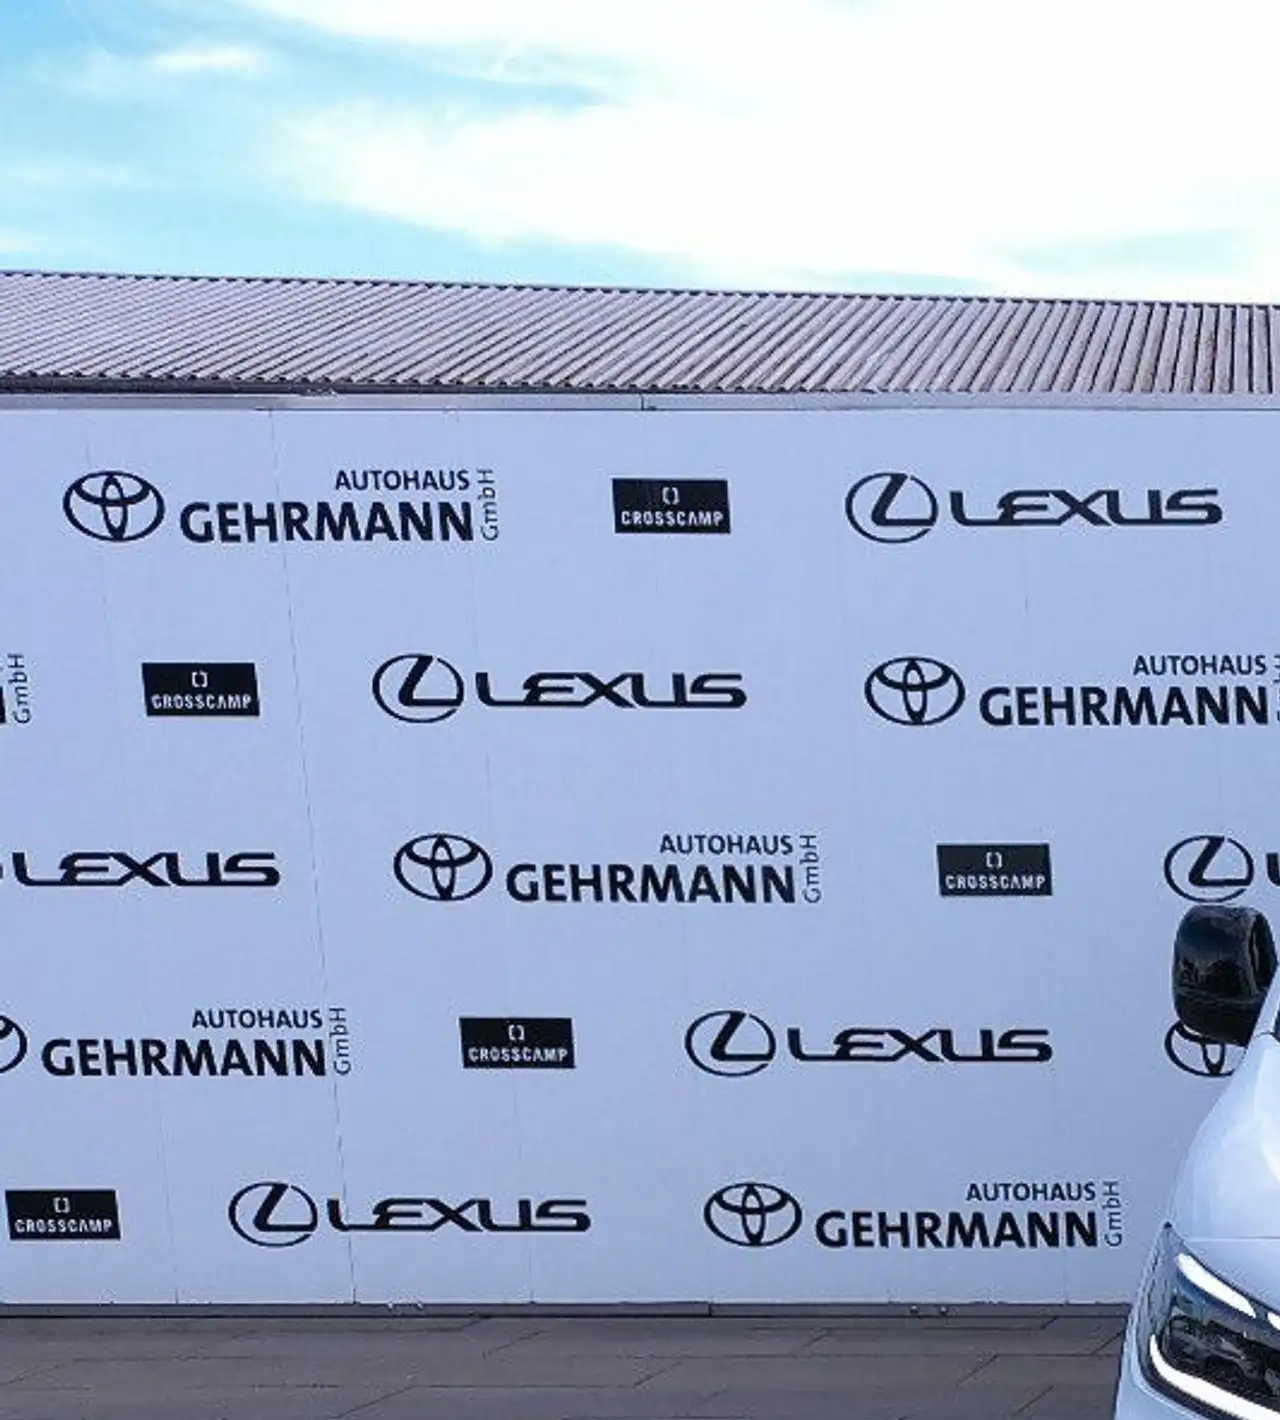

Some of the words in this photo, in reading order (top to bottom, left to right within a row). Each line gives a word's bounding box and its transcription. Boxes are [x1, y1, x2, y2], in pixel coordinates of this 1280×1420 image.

[334, 470, 470, 491] AUTOHAUS
[180, 501, 474, 543] GEHRMANN
[477, 468, 500, 541] GmbH
[621, 510, 724, 526] CROSSCAMP
[951, 488, 1223, 527] LEXUS
[1133, 654, 1267, 676] AUTOHAUS
[7, 652, 32, 724] GmbH
[151, 694, 252, 709] CROSSCAMP
[475, 672, 748, 709] LEXUS
[979, 686, 1269, 727] GEHRMANN
[659, 834, 793, 855] AUTOHAUS
[11, 852, 281, 888] LEXUS
[506, 863, 796, 904] GEHRMANN
[800, 834, 822, 904] GmbH
[944, 875, 1046, 890] CROSSCAMP
[192, 1009, 323, 1029] AUTOHAUS
[41, 1038, 327, 1077] GEHRMANN
[329, 1006, 352, 1076] GmbH
[468, 1047, 568, 1064] CROSSCAMP
[787, 1028, 1054, 1063] LEXUS
[966, 1181, 1096, 1201] AUTOHAUS
[15, 1219, 113, 1234] CROSSCAMP
[326, 1199, 591, 1233] LEXUS
[815, 1210, 1098, 1249] GEHRMANN
[1102, 1180, 1123, 1247] GmbH
